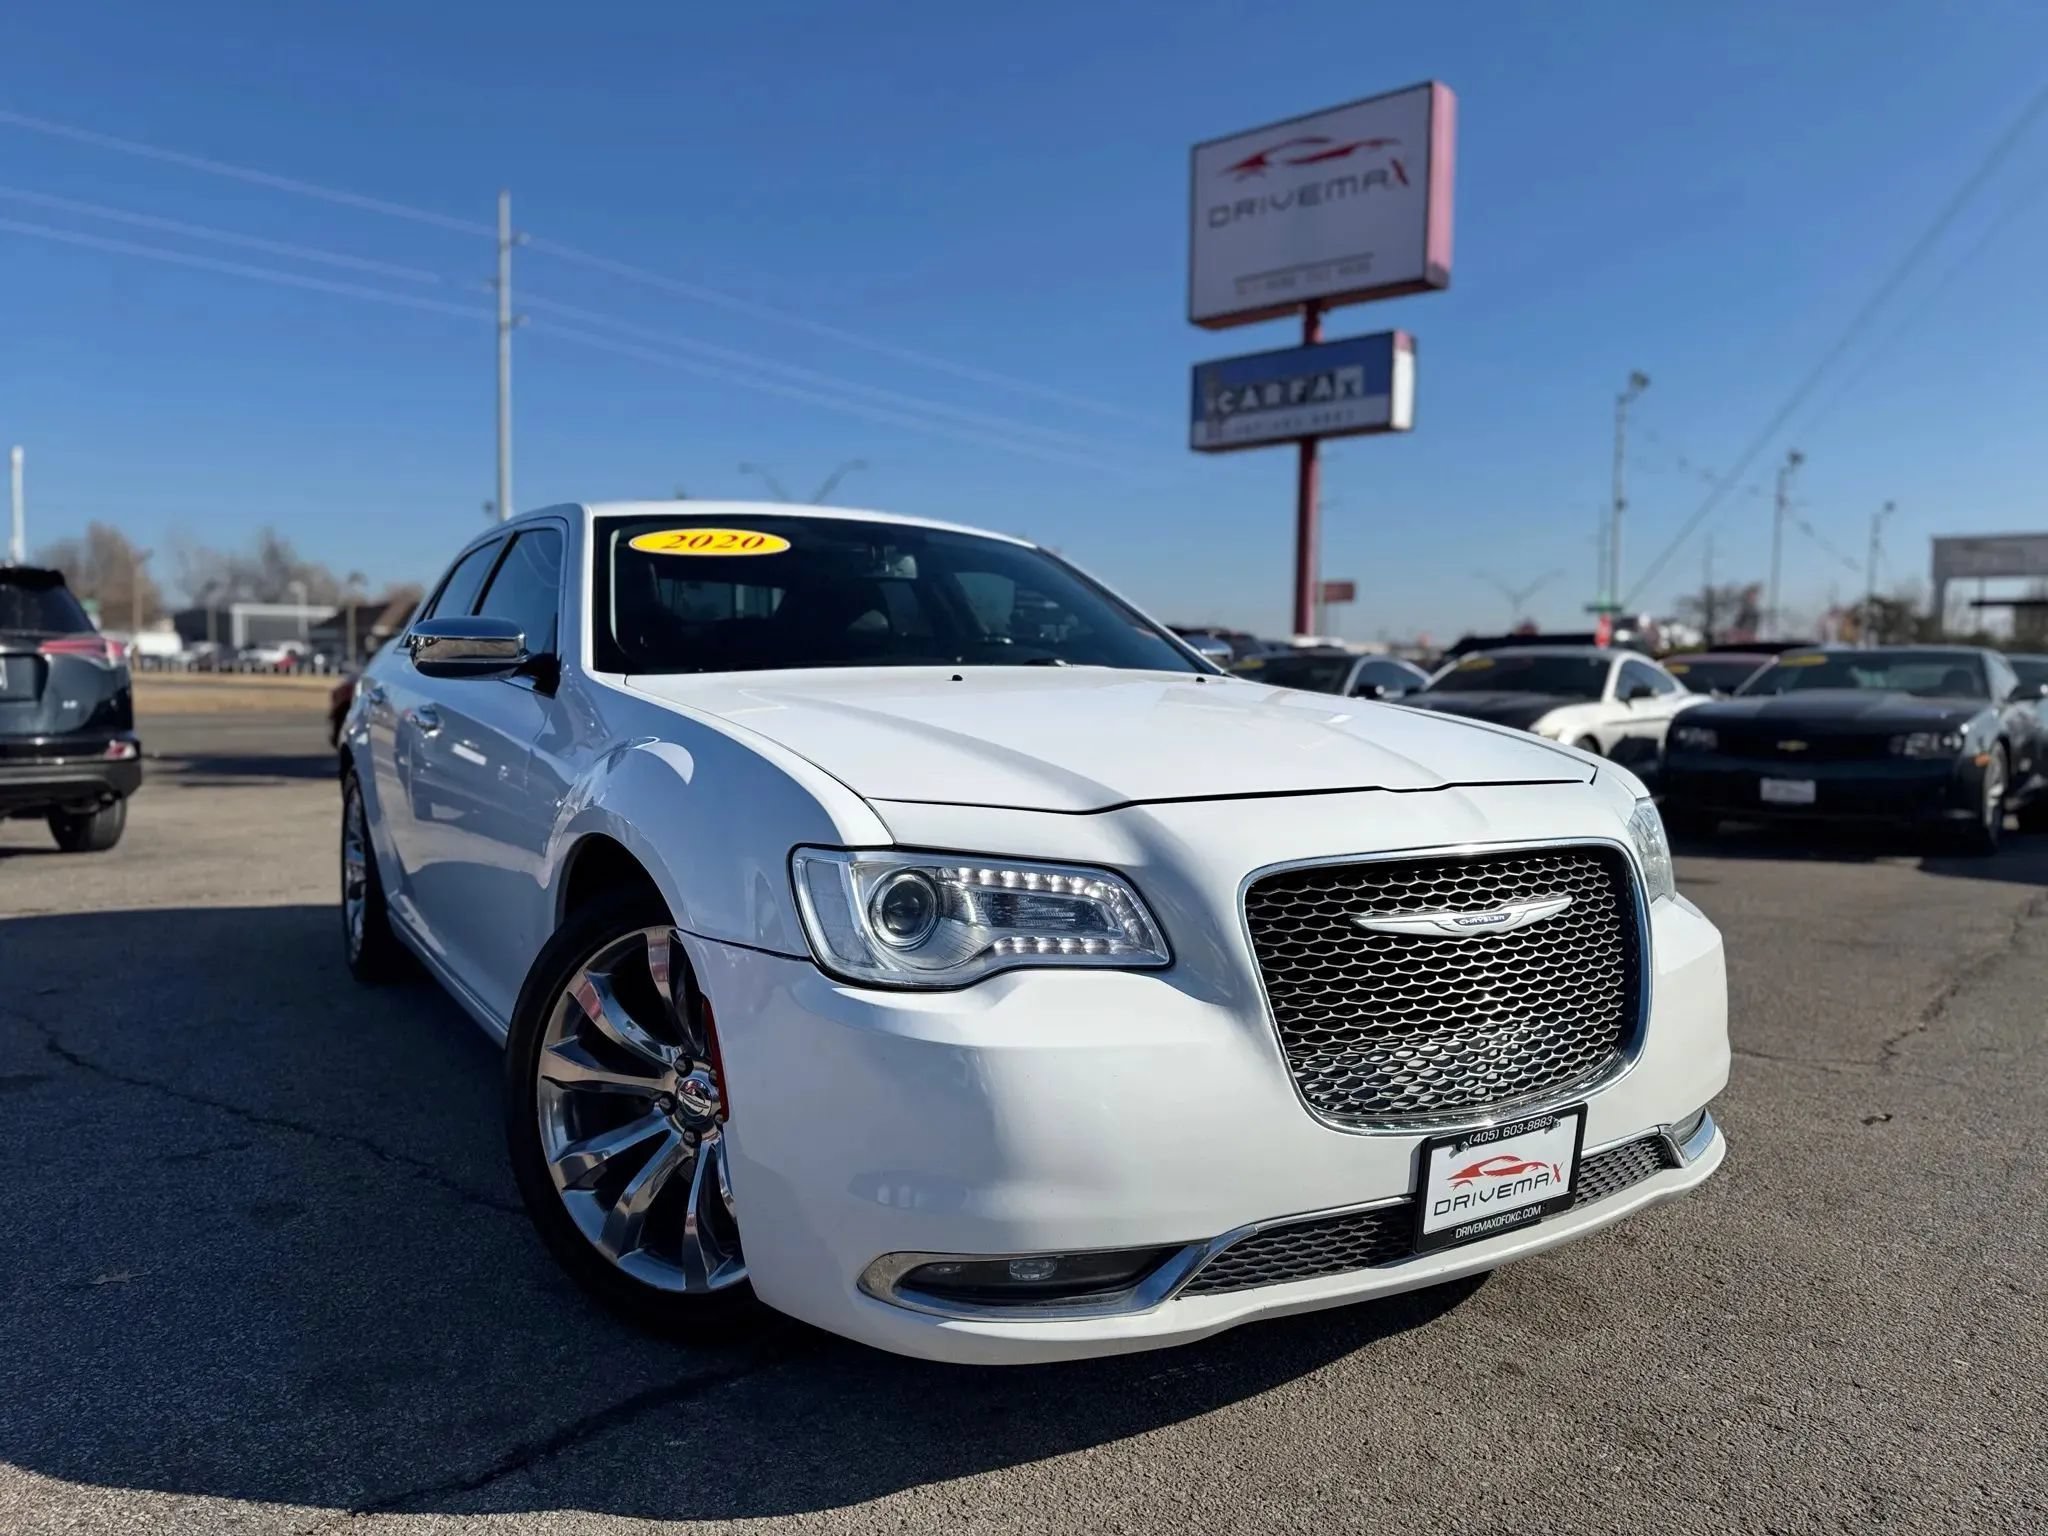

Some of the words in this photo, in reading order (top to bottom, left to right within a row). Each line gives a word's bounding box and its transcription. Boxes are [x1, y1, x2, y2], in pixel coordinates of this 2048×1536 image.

[1208, 155, 1409, 229] DRIVEMAX
[661, 534, 766, 549] 2020
[1459, 914, 1505, 925] CHRYSLER
[1469, 1128, 1500, 1145] (405)
[1503, 1115, 1553, 1138] 603-8883
[1433, 1161, 1564, 1217] DRIVEMAX
[1455, 1204, 1542, 1239] DRIVEMAXOFOKC.COM
